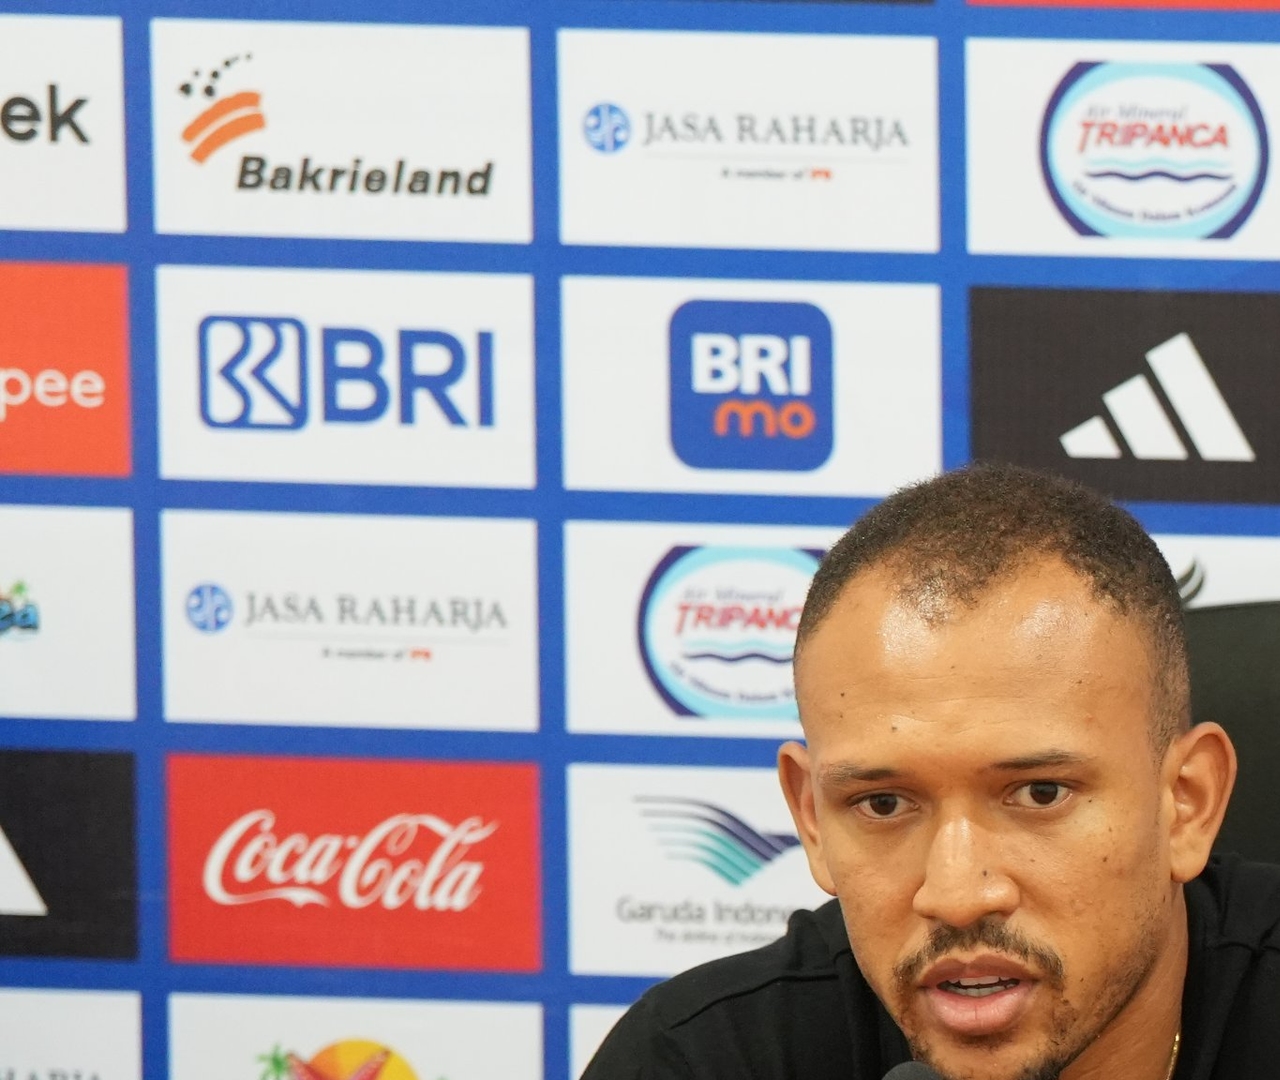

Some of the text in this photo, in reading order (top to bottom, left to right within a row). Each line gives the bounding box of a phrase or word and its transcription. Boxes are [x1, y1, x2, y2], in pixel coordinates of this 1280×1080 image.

[642, 113, 910, 151] JASA RAHARJA
[1078, 121, 1230, 153] TRIPANCA
[236, 155, 495, 197] Bakrieland
[321, 327, 496, 428] BRI
[690, 333, 811, 396] BRI
[712, 400, 816, 439] mo
[245, 594, 508, 633] JASA RAHARJA
[676, 605, 803, 638] TRIPANC
[204, 809, 498, 912] Coca-Cola
[615, 896, 706, 923] Garuda
